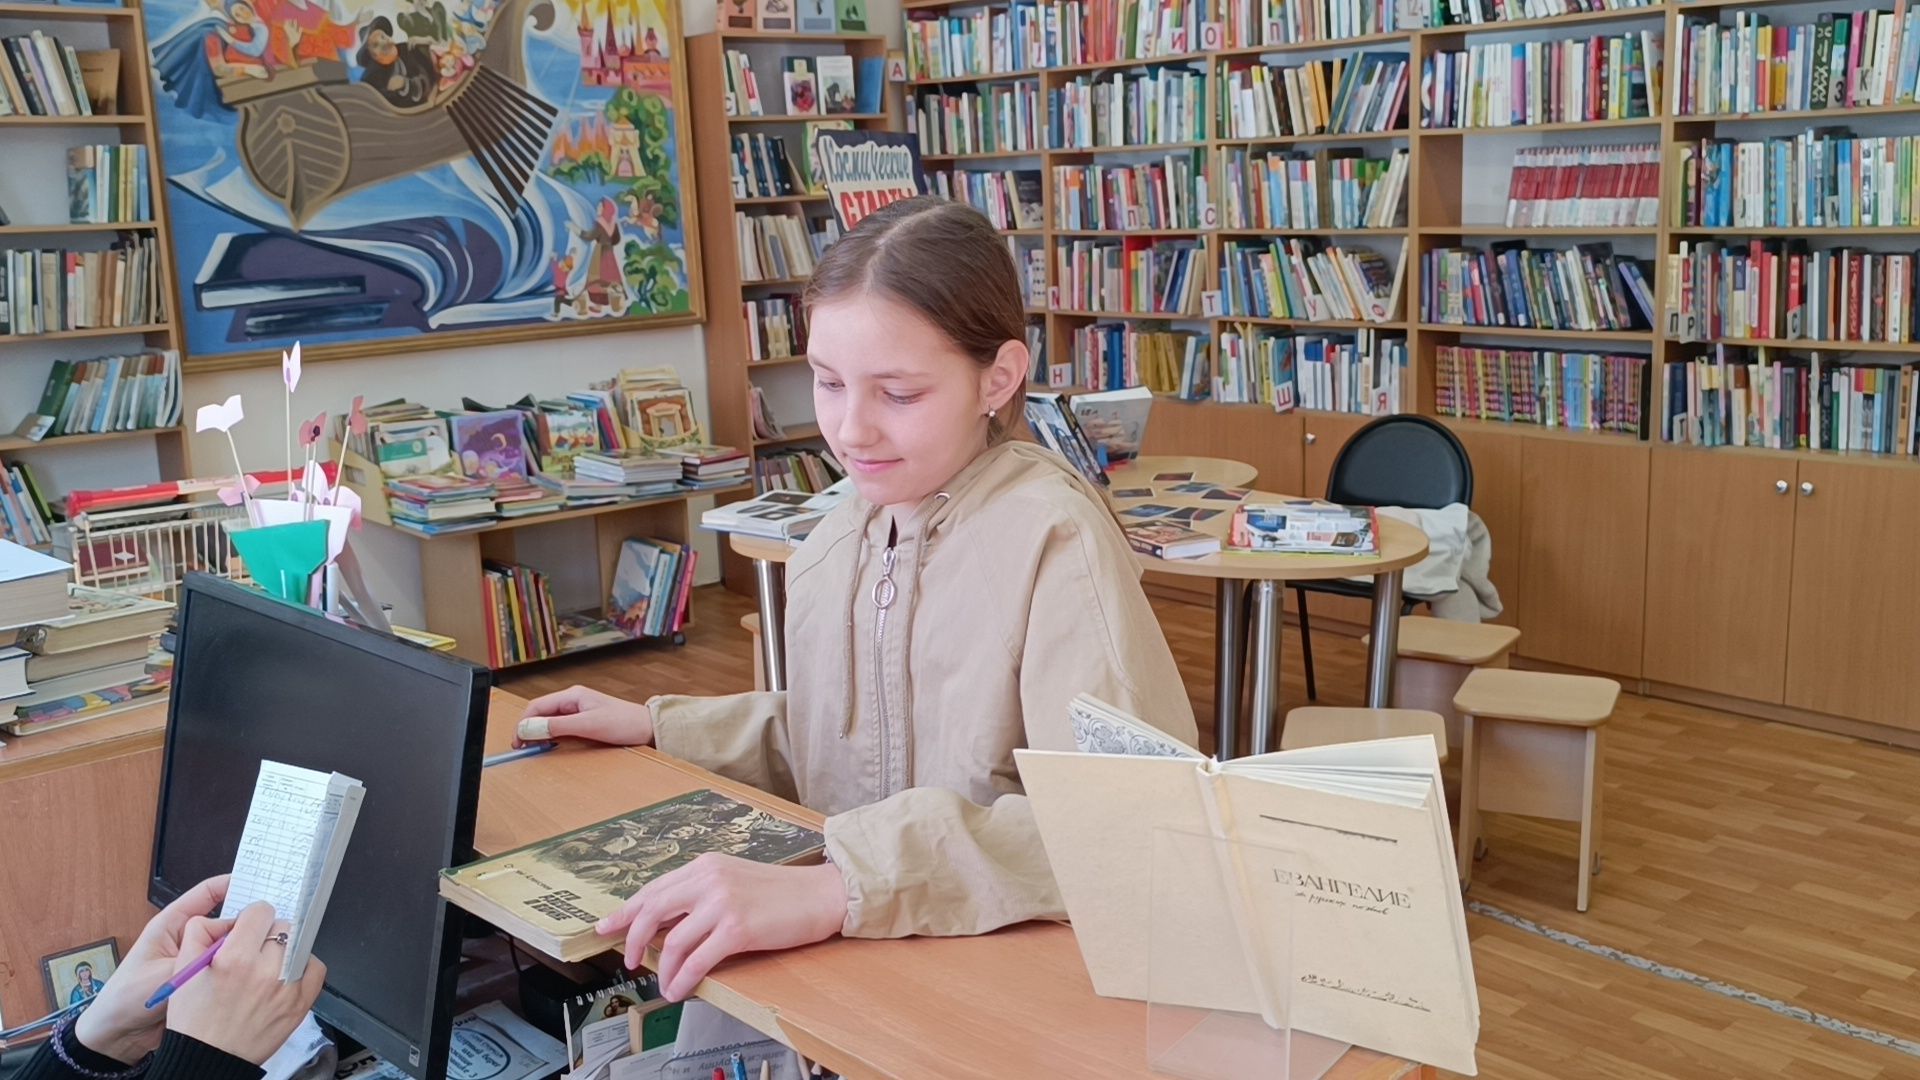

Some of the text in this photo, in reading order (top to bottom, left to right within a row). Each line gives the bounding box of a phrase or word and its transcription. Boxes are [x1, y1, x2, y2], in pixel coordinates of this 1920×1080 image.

[1204, 26, 1217, 45] О
[892, 62, 903, 77] А
[1859, 69, 1870, 91] К
[1834, 81, 1844, 102] З
[1204, 208, 1215, 226] С
[1205, 295, 1215, 312] Т
[1669, 313, 1679, 333] П
[1687, 316, 1695, 336] Р
[1053, 368, 1063, 384] Н
[1276, 386, 1292, 407] Ш
[1377, 393, 1387, 412] Я
[1272, 867, 1413, 909] ЕВАНГЕЛИЕ
